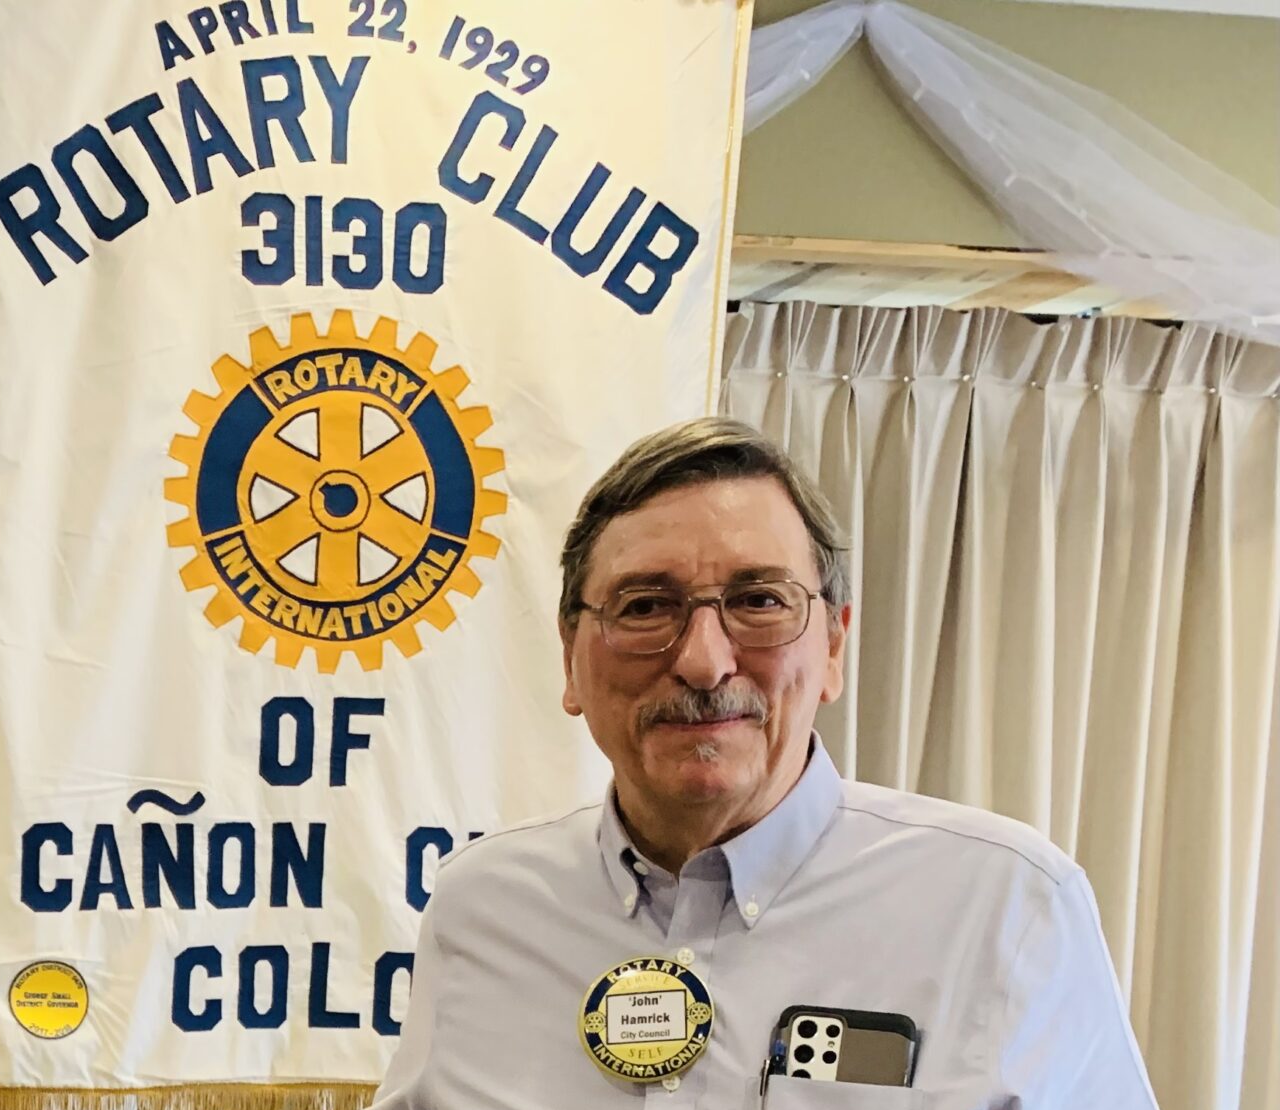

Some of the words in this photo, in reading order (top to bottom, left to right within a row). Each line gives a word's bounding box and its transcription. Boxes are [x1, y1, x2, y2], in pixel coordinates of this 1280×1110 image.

[154, 0, 314, 71] APRIL
[347, 0, 417, 54] 22,
[438, 15, 551, 96] 1929
[241, 192, 447, 294] 3130
[438, 91, 699, 315] CLUB
[264, 353, 423, 407] ROTARY
[213, 536, 458, 639] INTERNATIONAL
[259, 696, 385, 786] OF
[21, 789, 326, 913] CAÑON
[405, 826, 485, 913] C
[606, 959, 686, 984] ROTARY
[593, 1035, 705, 1077] INTERNATIONAL
[620, 1031, 636, 1039] City
[638, 1029, 670, 1038] Council
[621, 1013, 670, 1025] Hamrick
